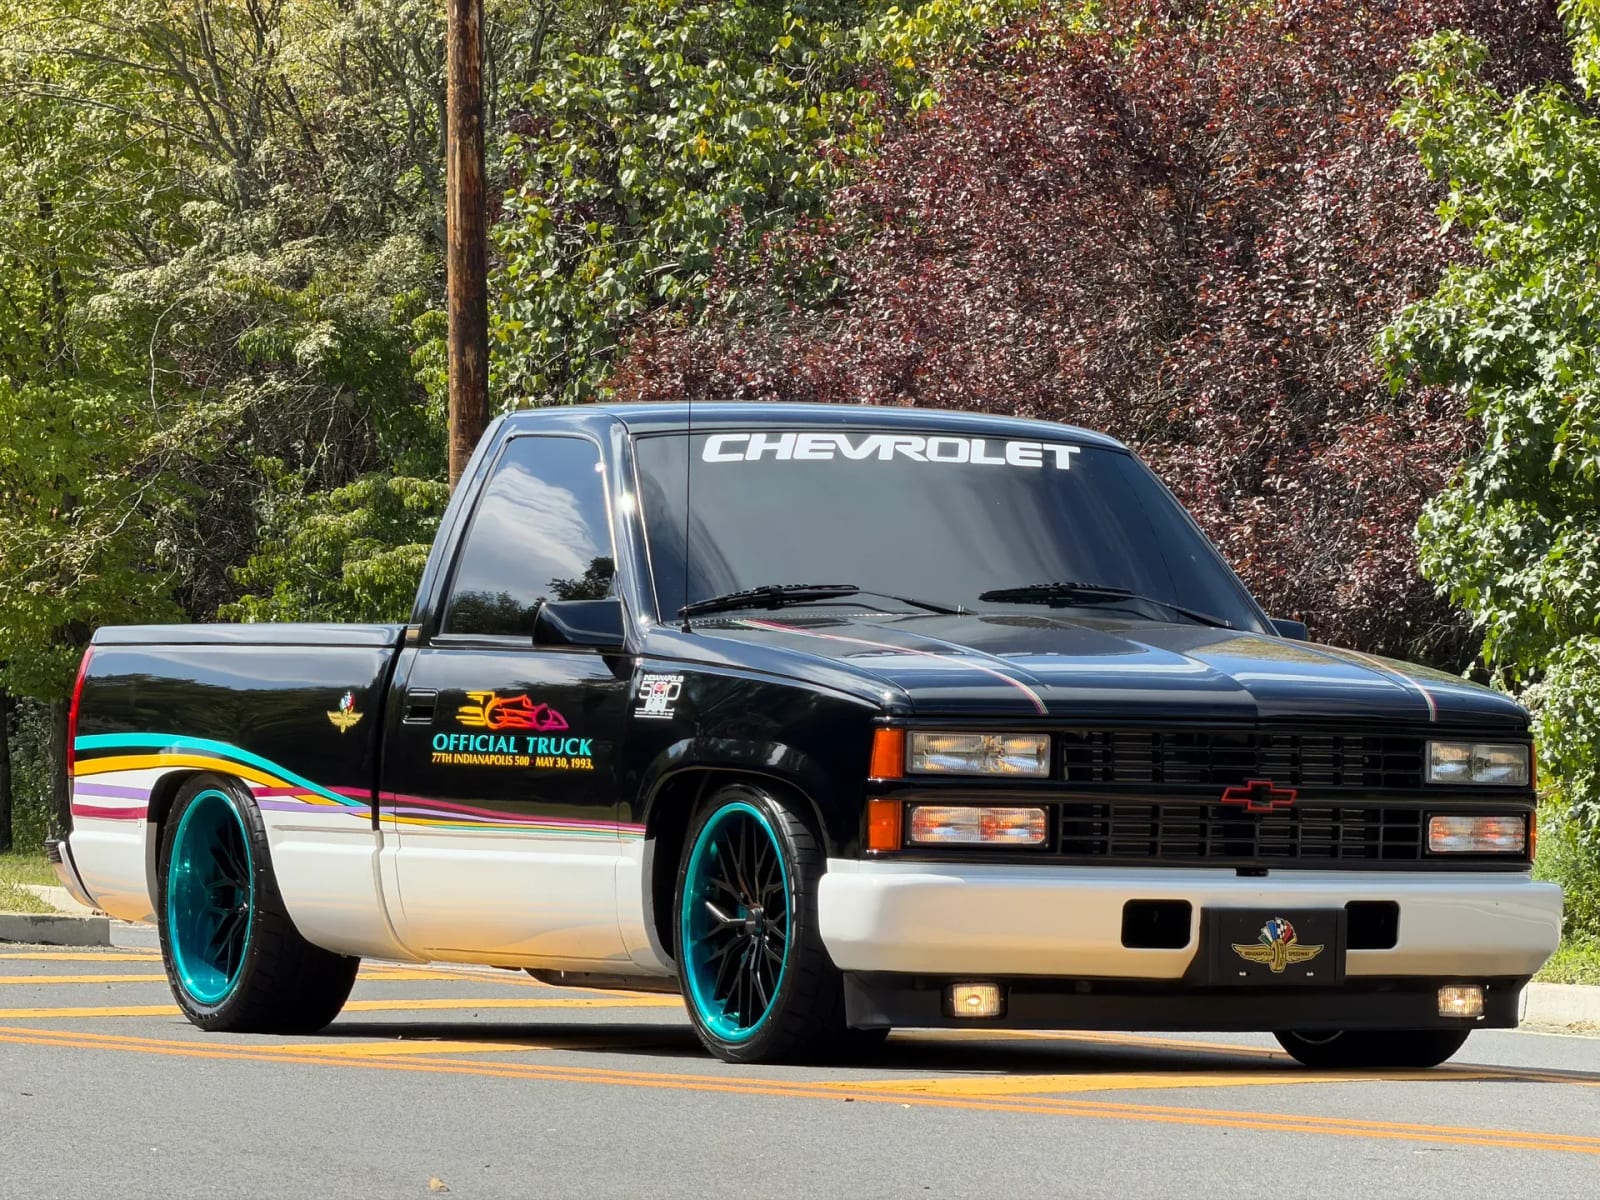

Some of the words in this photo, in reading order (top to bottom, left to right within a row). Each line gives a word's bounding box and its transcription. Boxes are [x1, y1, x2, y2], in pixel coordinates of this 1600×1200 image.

[702, 433, 1081, 470] CHEVROLET
[432, 733, 518, 753] OFFICIAL
[526, 736, 593, 756] TRUCK
[432, 752, 453, 764] 77TH
[453, 753, 514, 766] INDIANAPOLIS
[514, 755, 530, 766] 500
[535, 756, 555, 767] MAY
